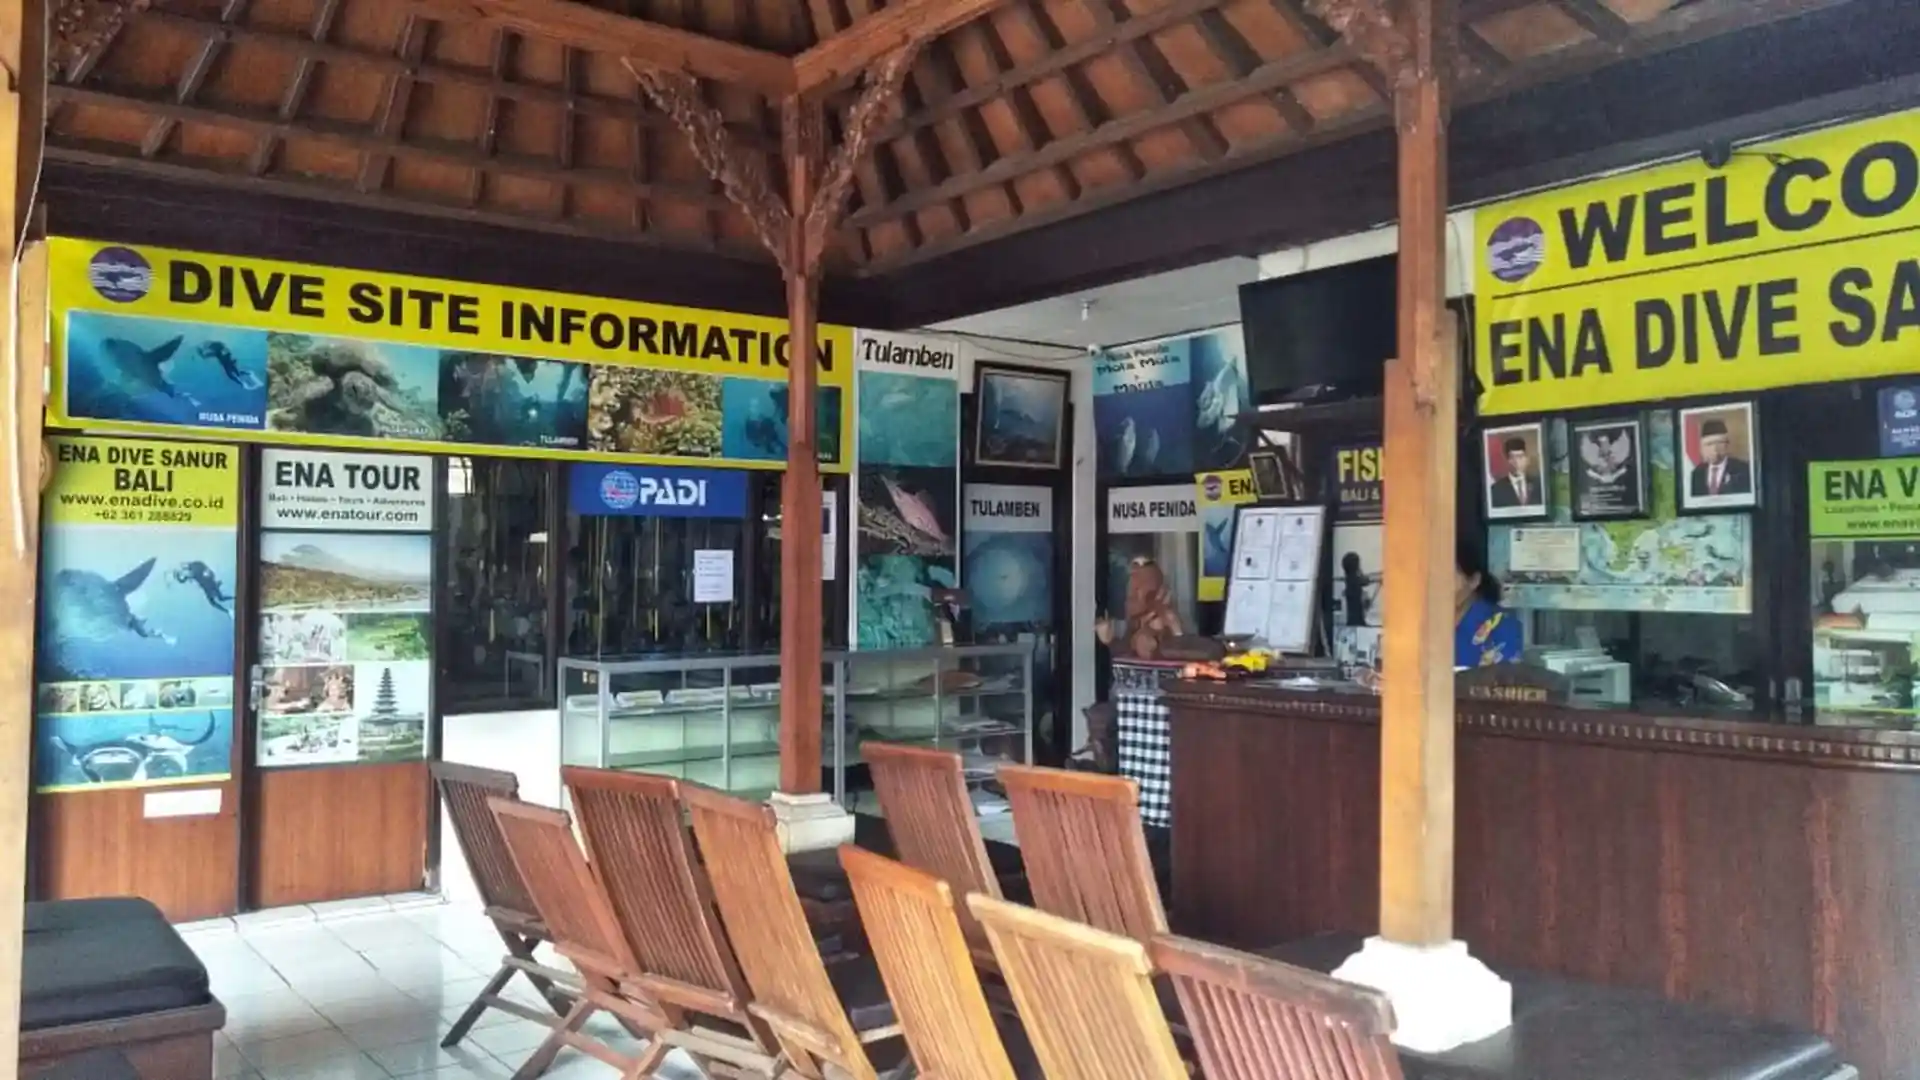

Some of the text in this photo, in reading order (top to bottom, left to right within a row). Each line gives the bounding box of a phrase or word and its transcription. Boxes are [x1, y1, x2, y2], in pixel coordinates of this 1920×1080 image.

[1558, 139, 1919, 269] WELCO
[169, 260, 325, 318] DIVE
[347, 282, 479, 335] SITE
[1489, 258, 1920, 387] ENA DIVE SA
[862, 338, 954, 370] Tulamben
[58, 443, 228, 470] ENA DIVE SANUR
[115, 468, 174, 493] BALI
[275, 460, 421, 492] ENA TOUR
[1228, 477, 1258, 496] EN
[1823, 467, 1888, 501] ENA
[60, 492, 224, 510] www.enadive.co.id
[639, 476, 708, 508] PADI
[276, 507, 419, 522] www.enatour.com
[969, 498, 1042, 518] TULAMBEN
[1112, 500, 1197, 519] NUSA PENIDA
